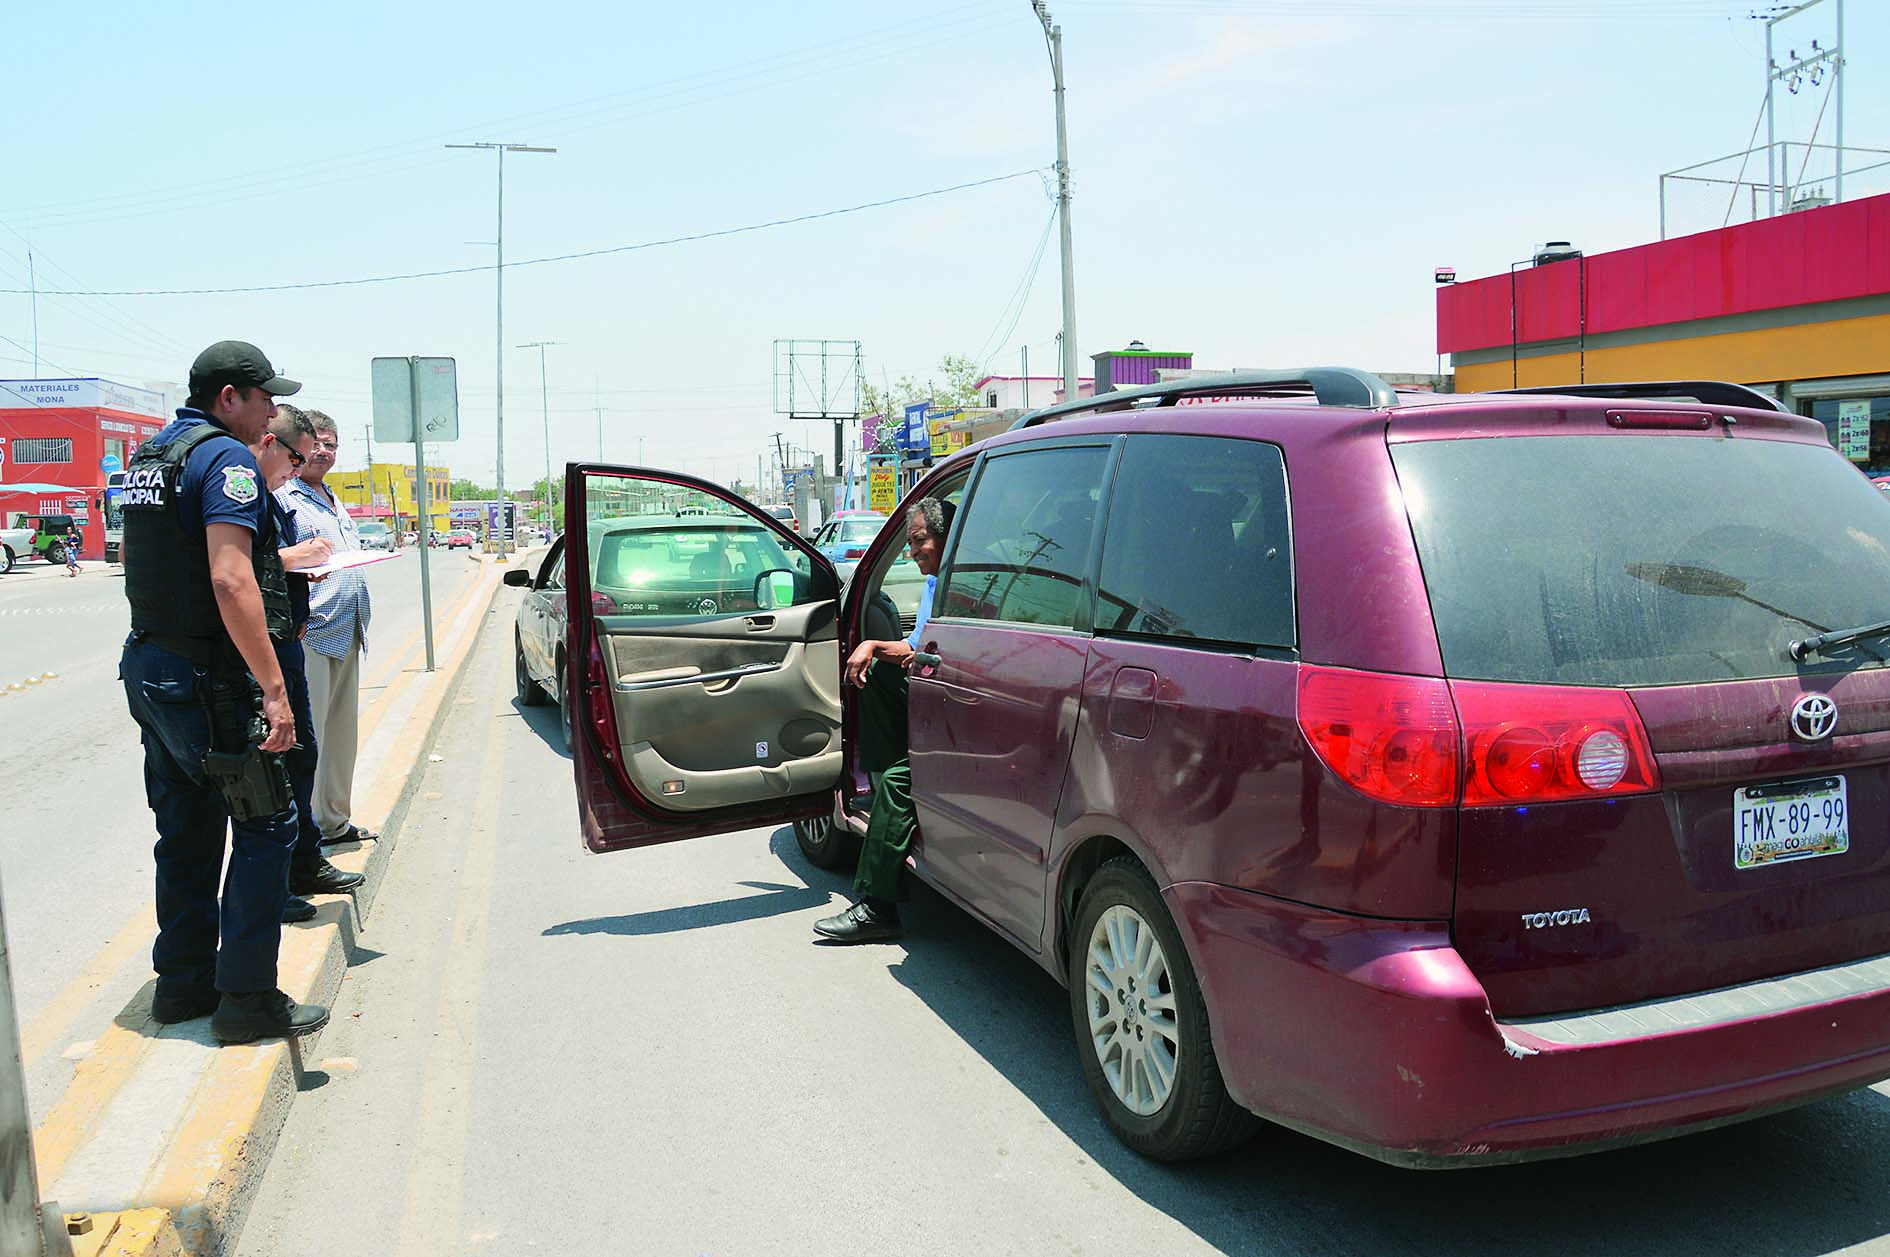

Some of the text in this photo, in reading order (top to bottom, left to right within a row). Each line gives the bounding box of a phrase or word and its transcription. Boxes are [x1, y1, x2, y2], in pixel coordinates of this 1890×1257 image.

[20, 384, 80, 393] MATERIALES
[36, 396, 65, 404] MONA
[1741, 798, 1844, 844] FMX-89-99
[1521, 908, 1591, 930] TOYOTA
